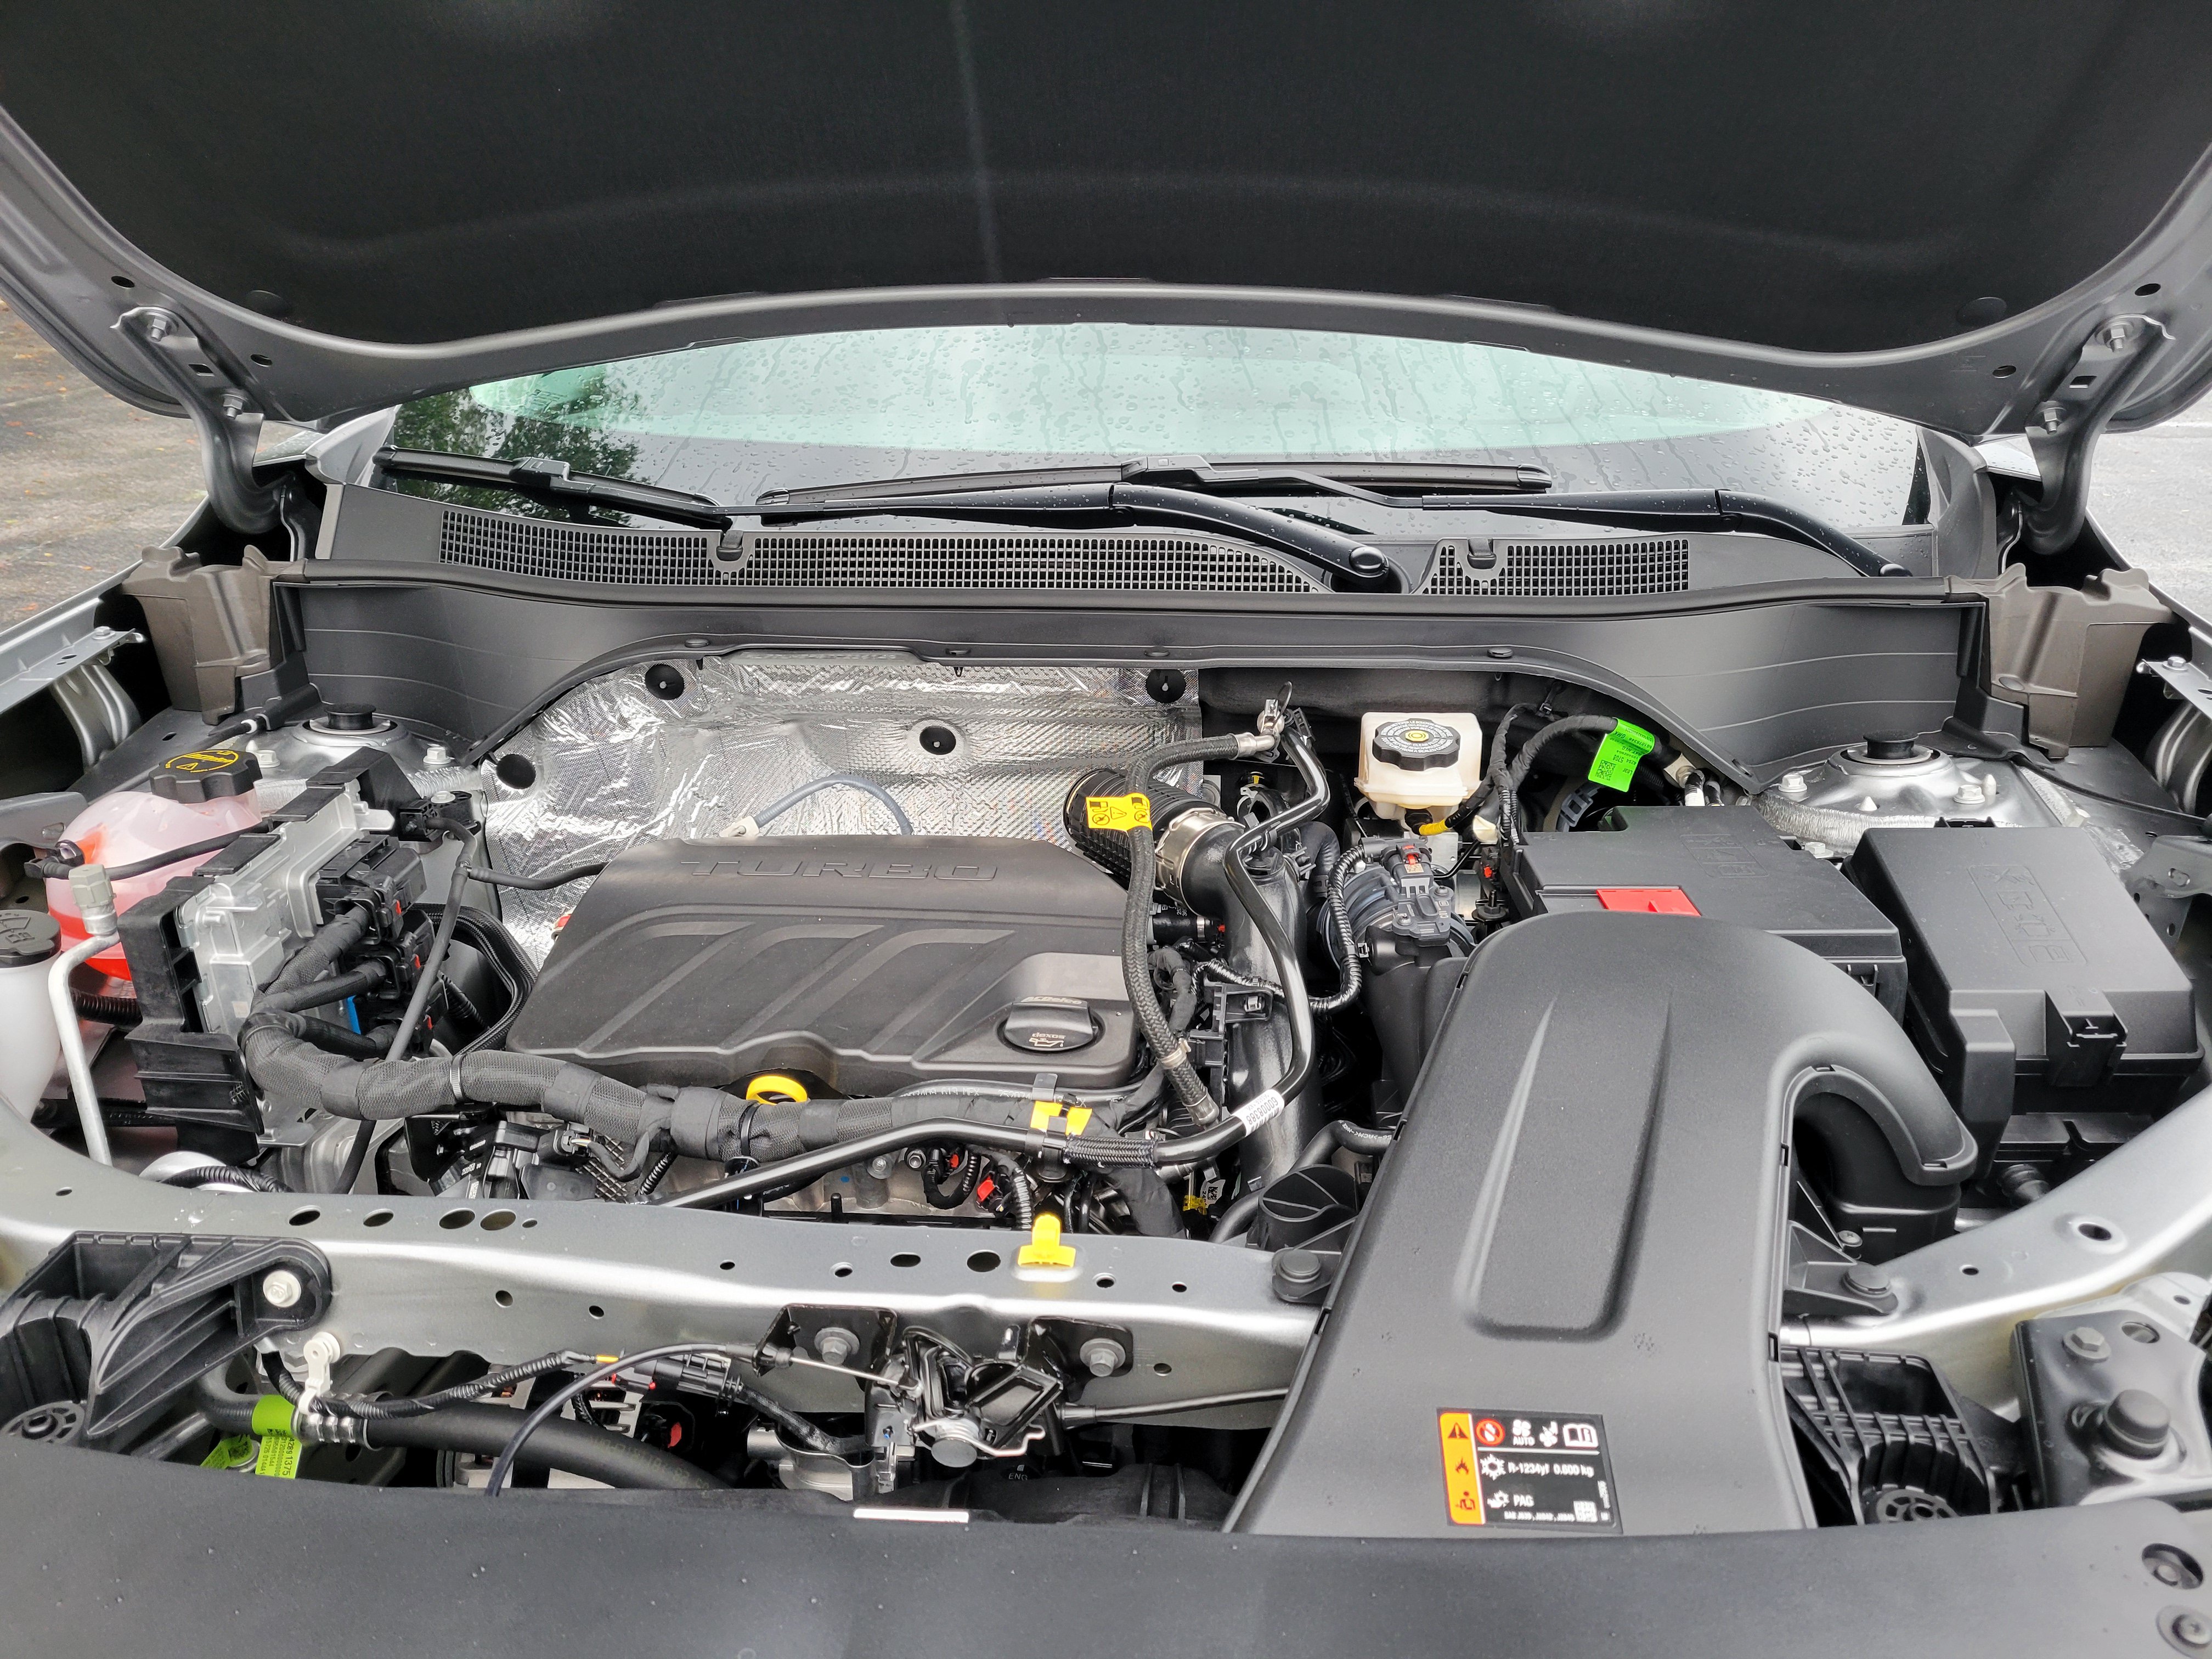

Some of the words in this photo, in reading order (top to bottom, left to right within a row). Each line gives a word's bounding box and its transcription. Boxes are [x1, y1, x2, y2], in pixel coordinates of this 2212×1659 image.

[679, 860, 1000, 881] TURBO
[1246, 1097, 1278, 1125] 60008388
[1513, 1436, 1535, 1446] AUTO
[282, 1456, 294, 1476] 1375
[1508, 1462, 1550, 1476] R-1234yf
[1581, 1465, 1595, 1478] kg
[1513, 1494, 1534, 1507] PAG
